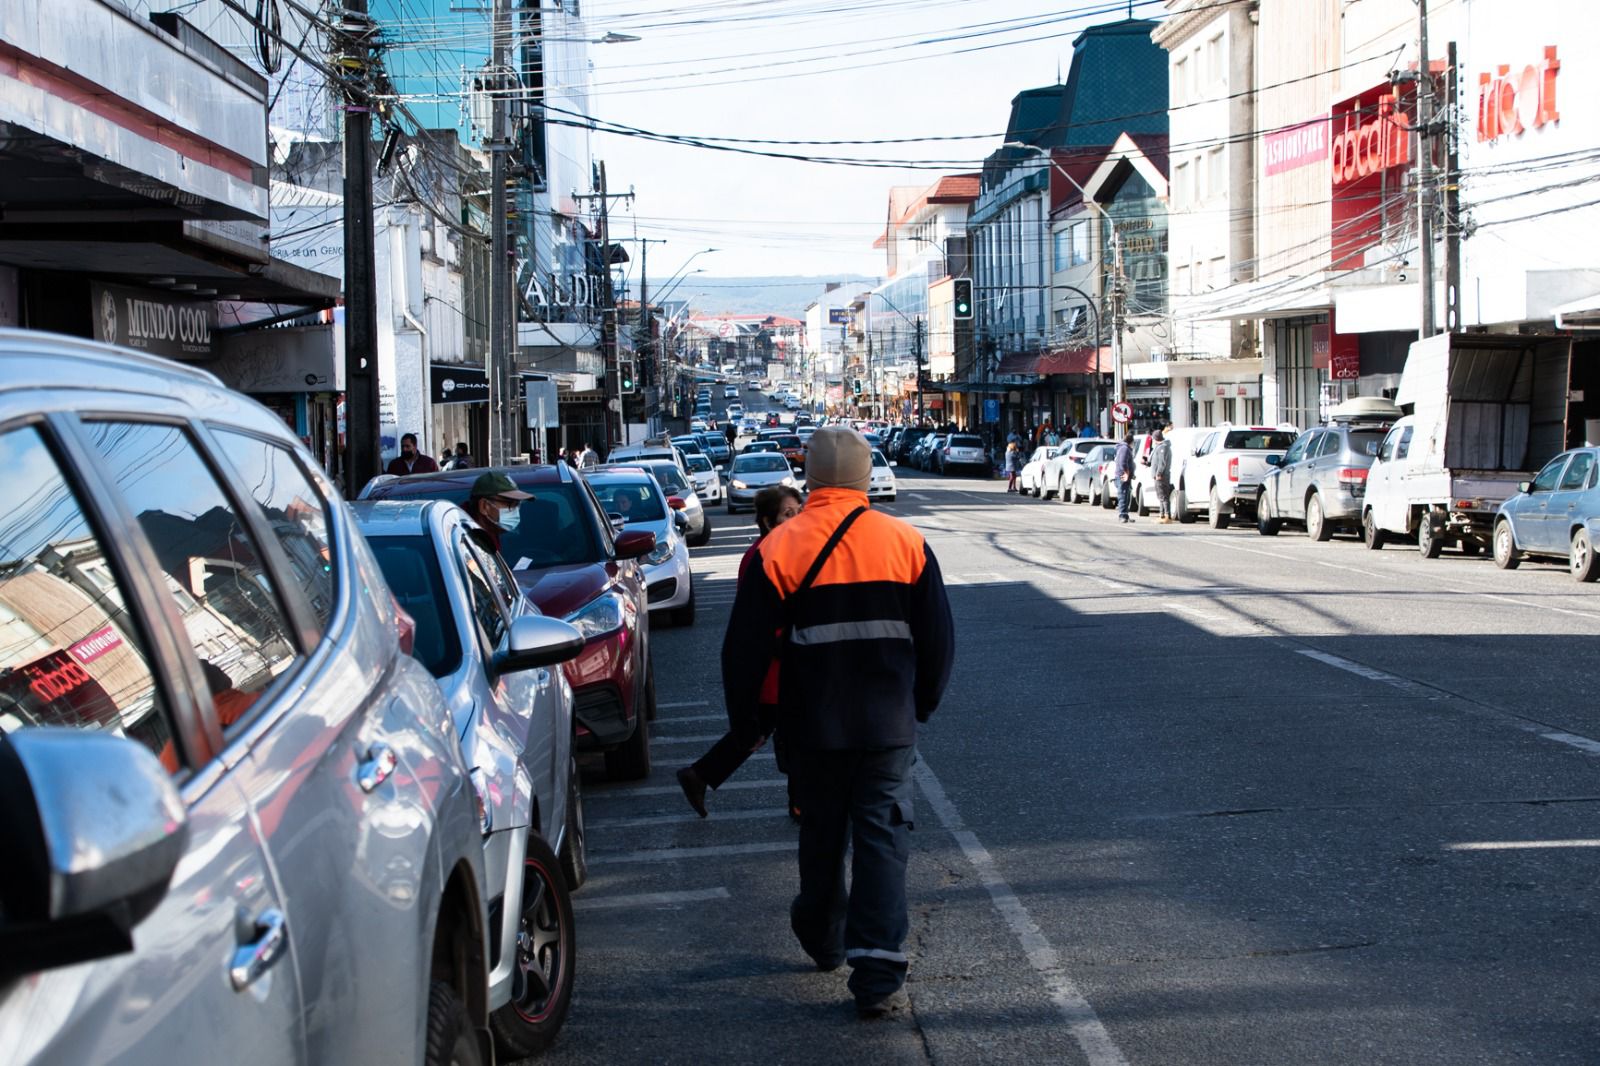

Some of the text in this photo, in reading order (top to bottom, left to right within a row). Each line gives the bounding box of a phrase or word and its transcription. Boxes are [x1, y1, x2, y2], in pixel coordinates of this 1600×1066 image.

[1477, 45, 1561, 143] tricot
[1332, 94, 1409, 184] abcdin
[292, 248, 301, 257] DE
[126, 297, 211, 344] MUNDO COOL
